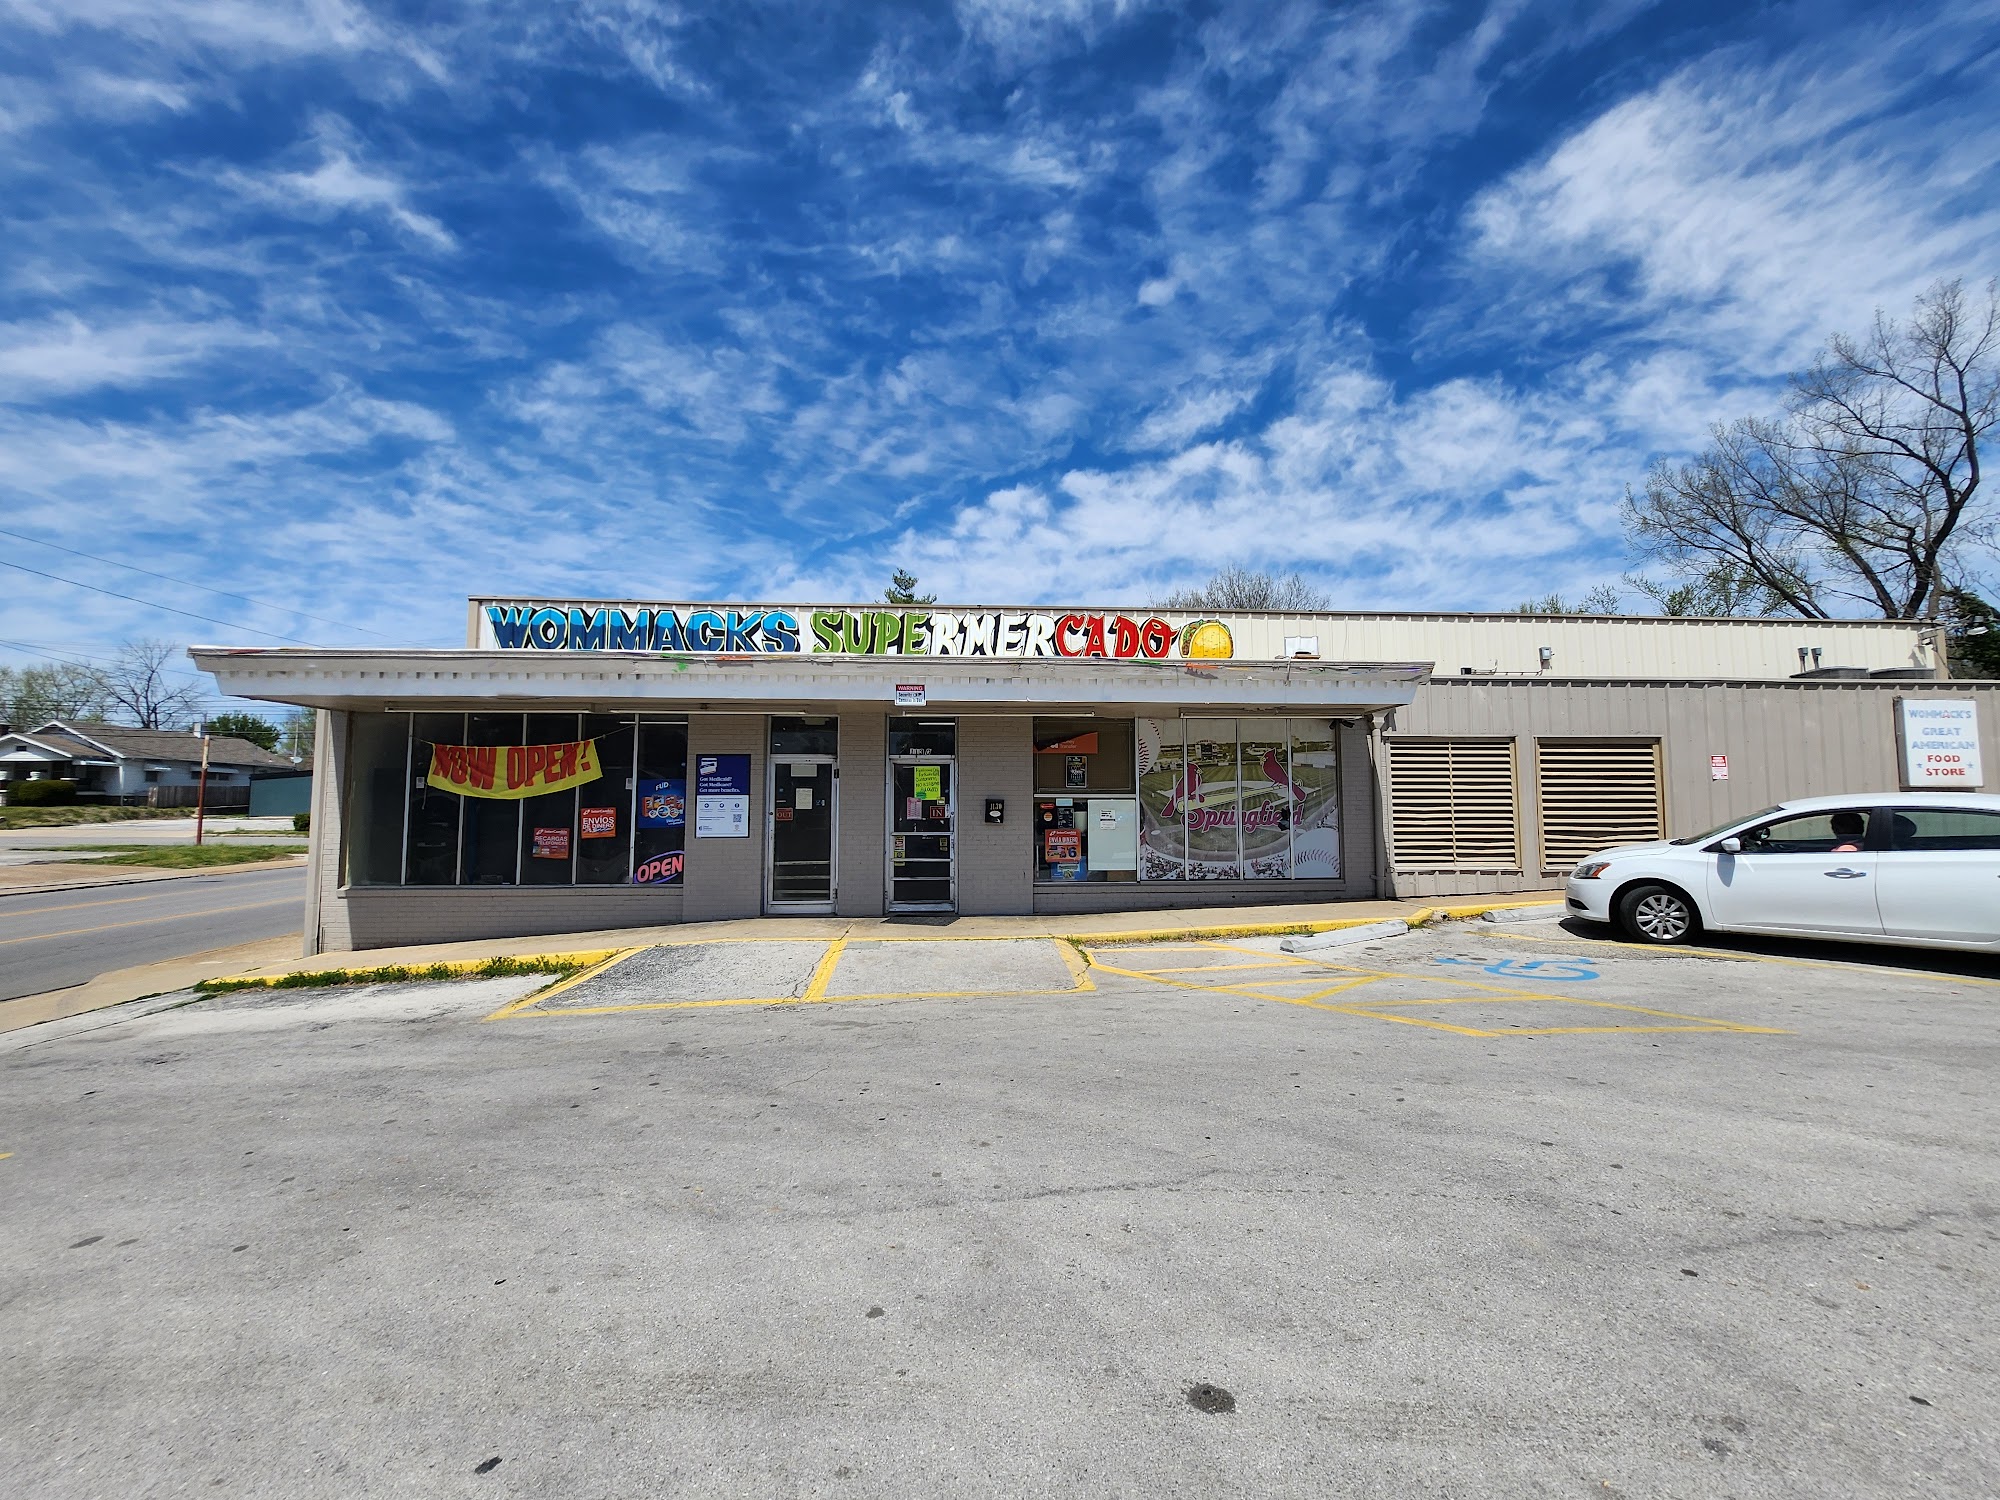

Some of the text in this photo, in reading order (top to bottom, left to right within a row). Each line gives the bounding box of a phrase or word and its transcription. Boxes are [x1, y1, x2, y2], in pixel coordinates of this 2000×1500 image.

[485, 606, 1181, 658] WOMMACKS SUPERMERCADO
[1922, 727, 1961, 736] GREAT
[1912, 741, 1976, 749] AMERICAN
[1927, 755, 1961, 763] FOOD
[433, 740, 592, 790] NOW OPEN!
[1926, 768, 1966, 776] STORE
[656, 781, 670, 791] FUD
[932, 809, 943, 817] IN
[1181, 800, 1304, 833] Springfied
[583, 815, 615, 825] ENVÍOS
[592, 822, 615, 830] DINERO
[636, 855, 684, 883] OPEN
